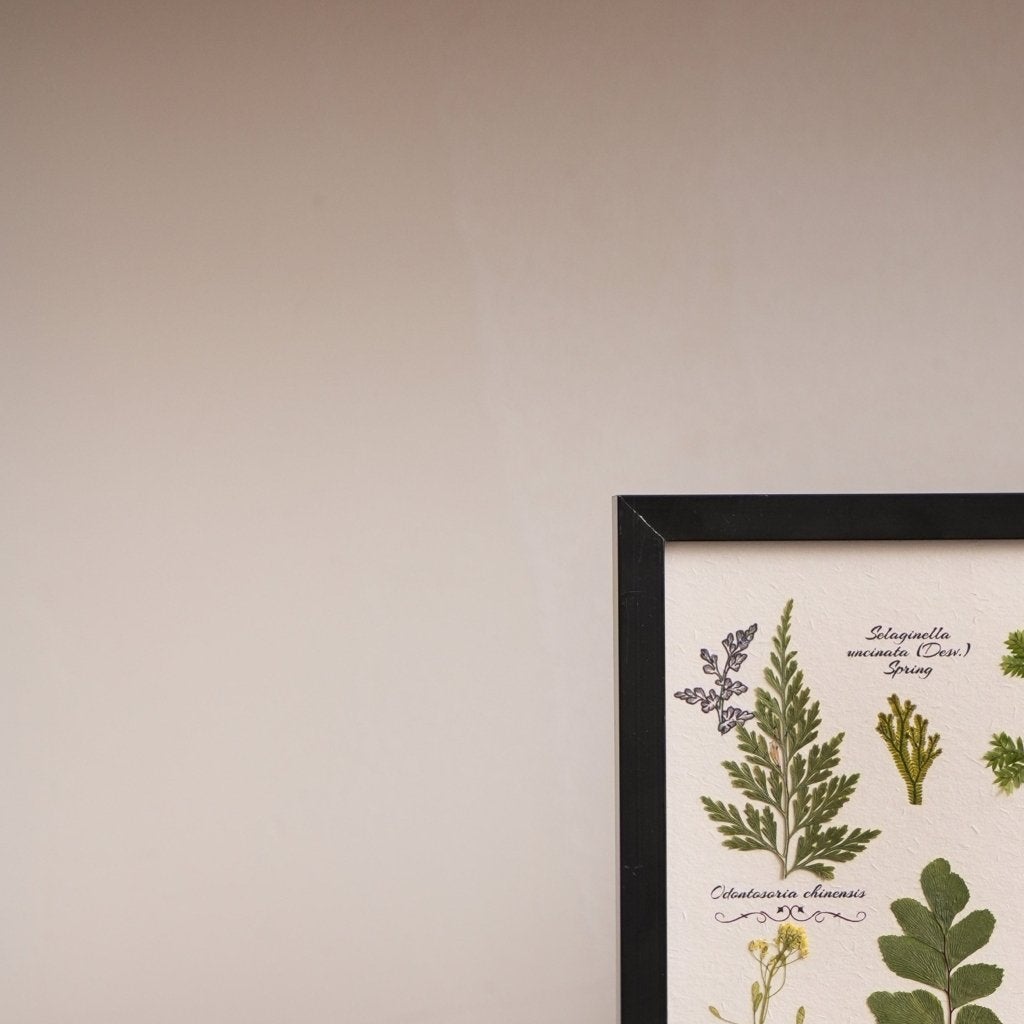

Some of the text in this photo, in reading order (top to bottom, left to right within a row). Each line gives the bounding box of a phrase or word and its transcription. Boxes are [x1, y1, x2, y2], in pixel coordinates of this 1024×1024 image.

[865, 625, 951, 645] Selaginella
[847, 642, 971, 658] uncinata (Desv.)
[883, 660, 933, 679] Spring
[710, 883, 866, 899] Odontosoria chinensis
